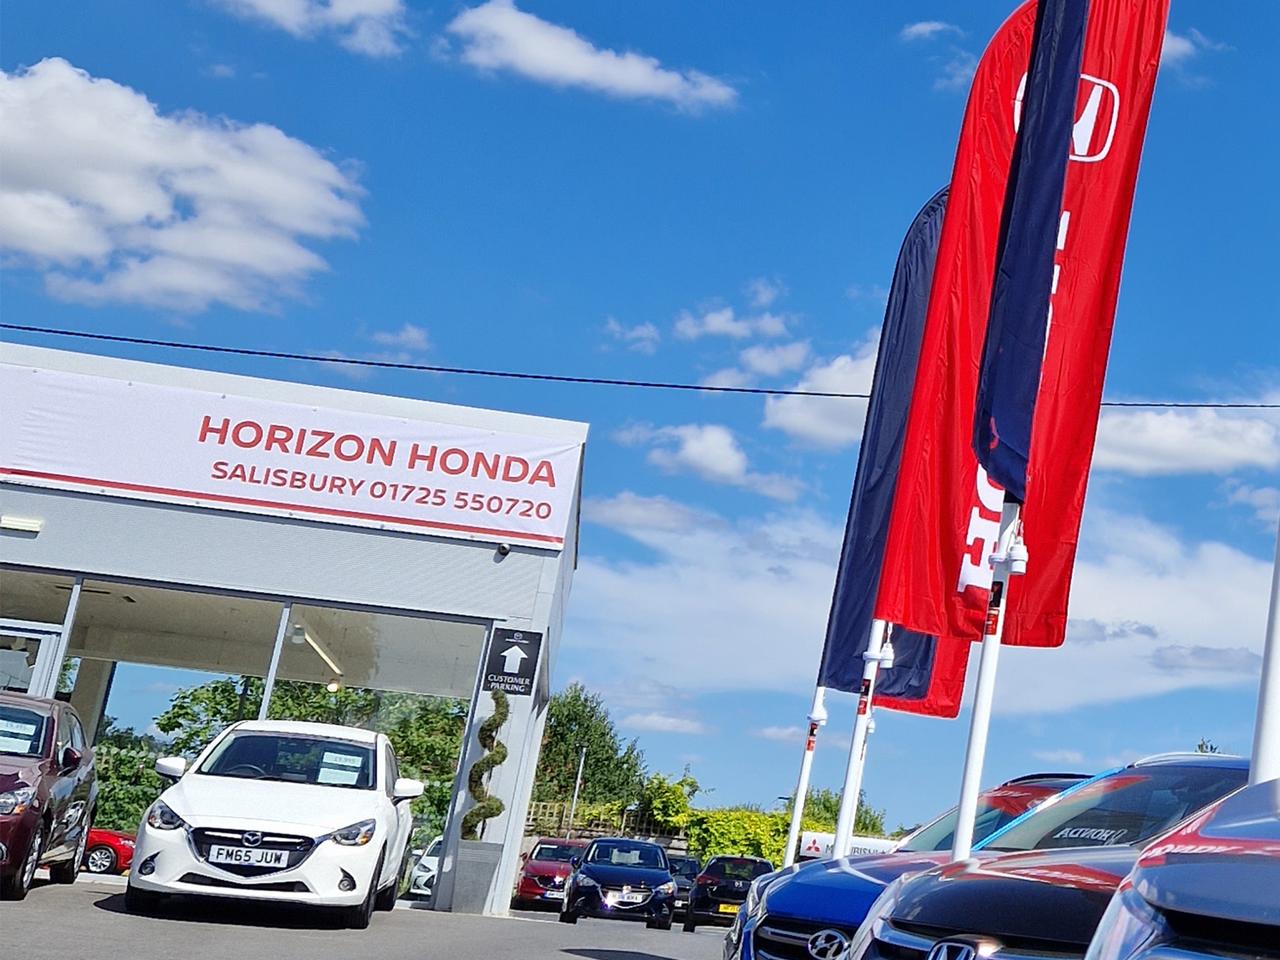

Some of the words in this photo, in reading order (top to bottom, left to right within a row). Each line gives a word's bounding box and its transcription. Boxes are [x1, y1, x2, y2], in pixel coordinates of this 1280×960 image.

[197, 415, 397, 467] HORIZON
[407, 443, 556, 488] HONDA
[211, 461, 365, 496] SALISBURY
[369, 481, 447, 507] 01725
[453, 491, 552, 520] 550720
[488, 674, 530, 685] CUSTOMER
[490, 682, 525, 692] PARKING
[216, 847, 252, 862] FM65
[255, 850, 283, 865] JUW
